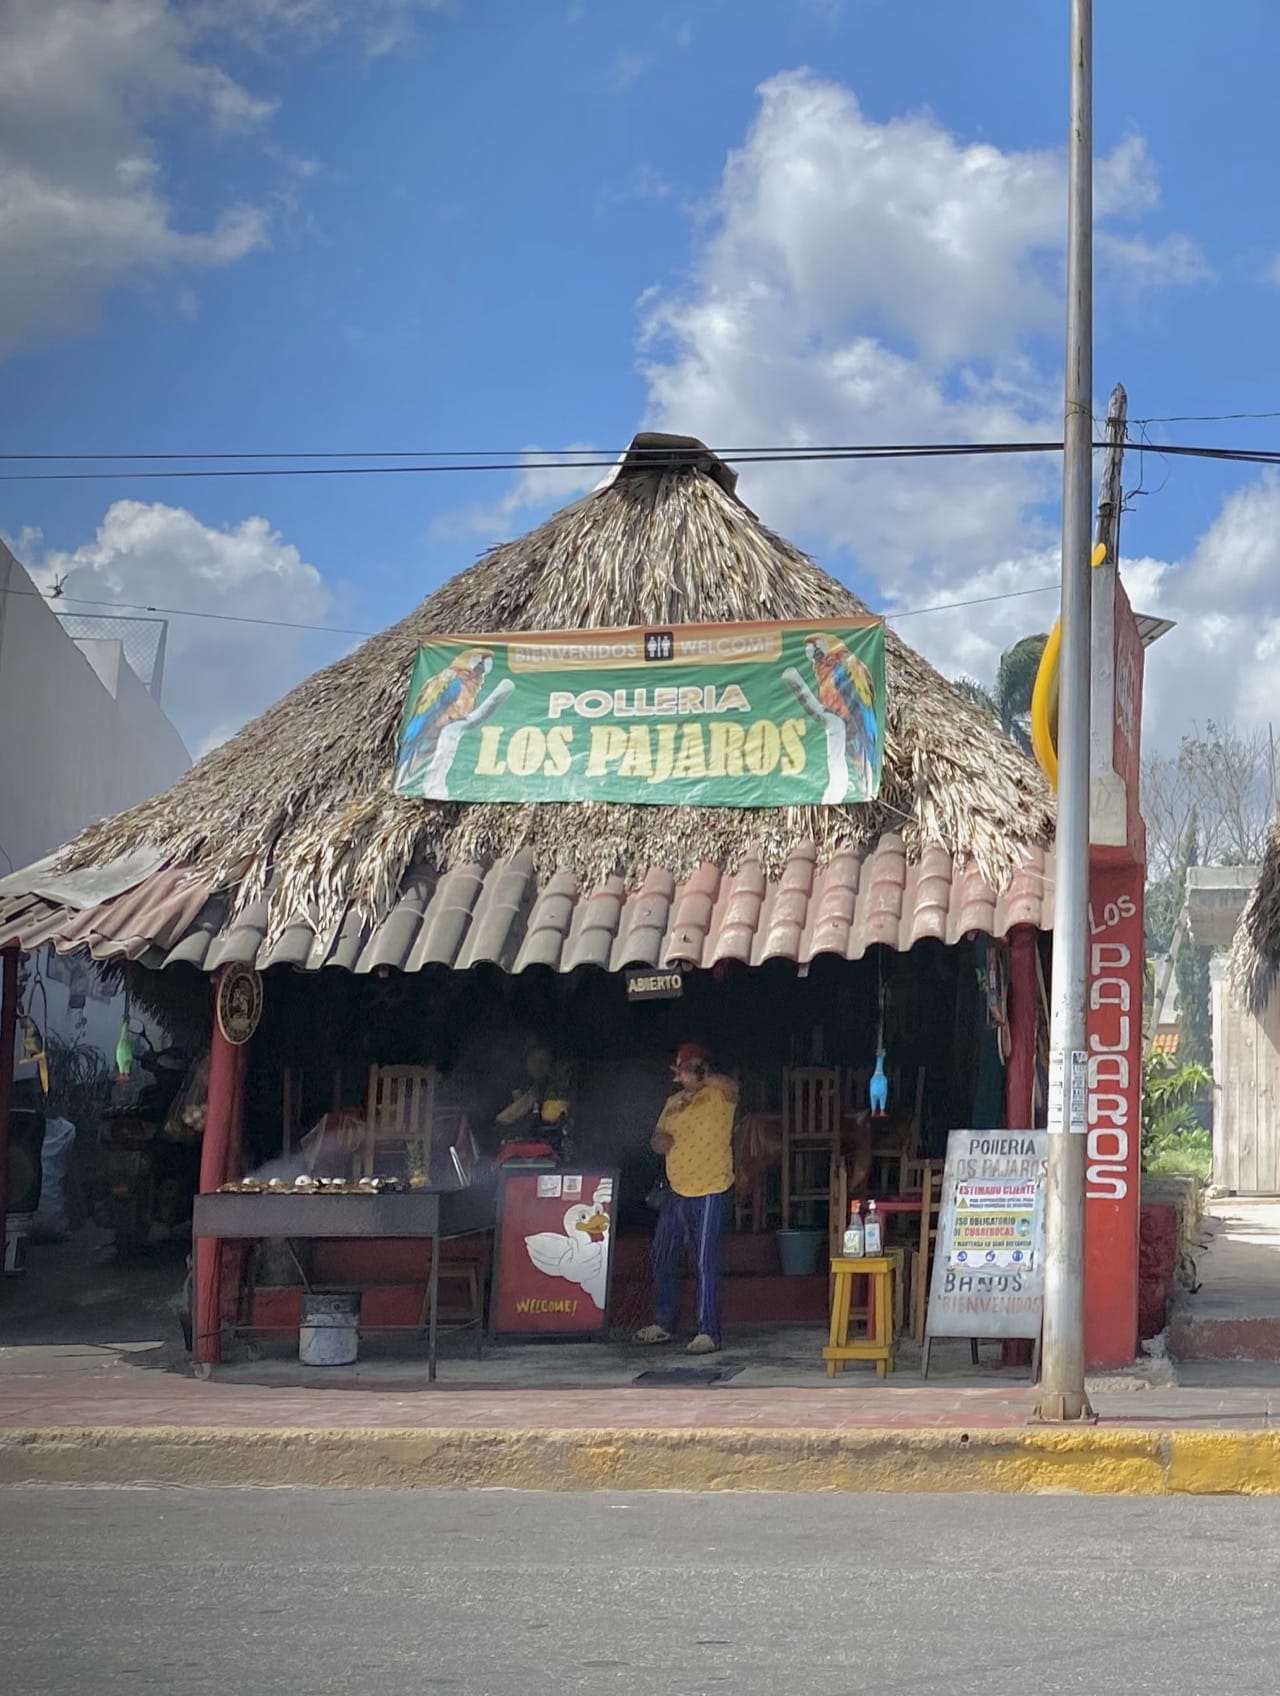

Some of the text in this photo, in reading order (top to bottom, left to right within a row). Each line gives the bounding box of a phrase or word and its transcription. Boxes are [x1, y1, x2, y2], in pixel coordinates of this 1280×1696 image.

[515, 636, 774, 662] BIENVENIDOS WELCOME
[548, 684, 752, 719] POLLERIA
[474, 718, 807, 784] LOS PAJAROS
[628, 974, 682, 993] ABIERTO
[1086, 943, 1131, 1199] PAJAROS
[1003, 1185, 1036, 1195] CLIENTE
[964, 1227, 1014, 1236] CUBREBOCAS
[969, 1217, 1016, 1226] OBLIGATORIO
